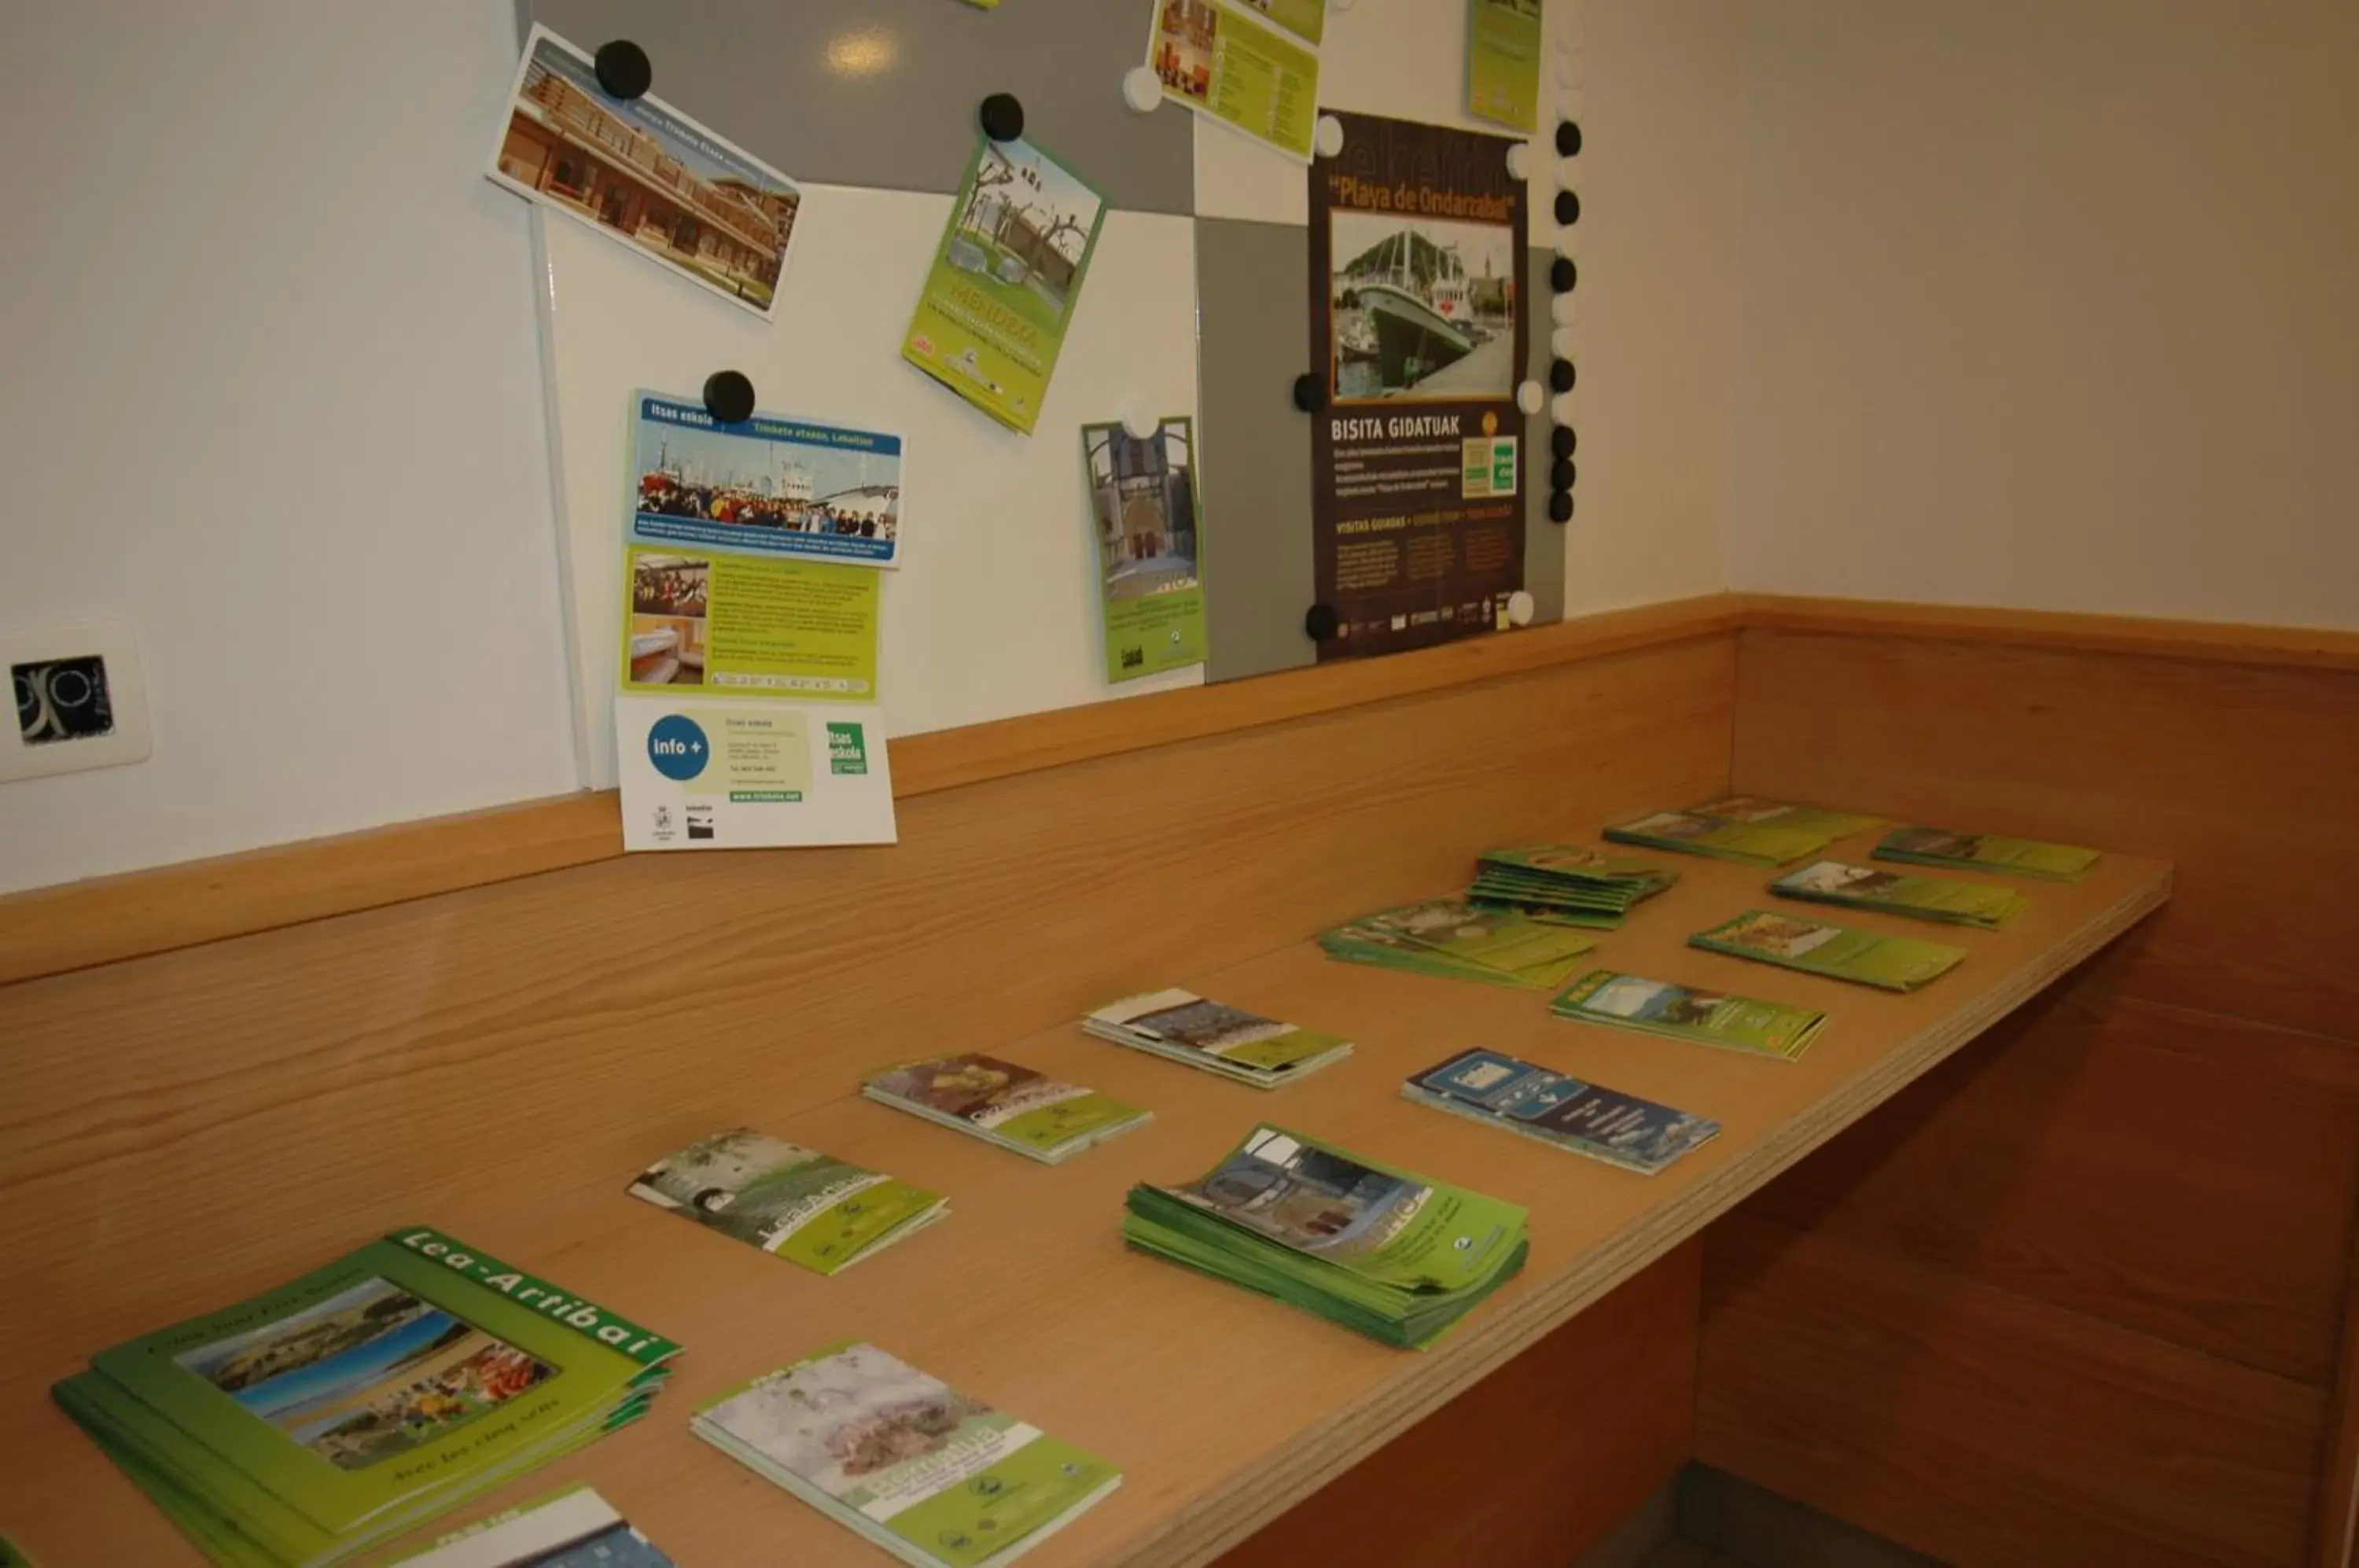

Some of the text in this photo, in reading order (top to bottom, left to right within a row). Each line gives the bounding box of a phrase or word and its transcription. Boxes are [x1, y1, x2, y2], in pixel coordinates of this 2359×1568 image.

[1394, 182, 1415, 210] de
[1330, 414, 1460, 442] BISITA GIDATUAK
[653, 738, 686, 755] info
[403, 1231, 660, 1354] Lea-Artibai
